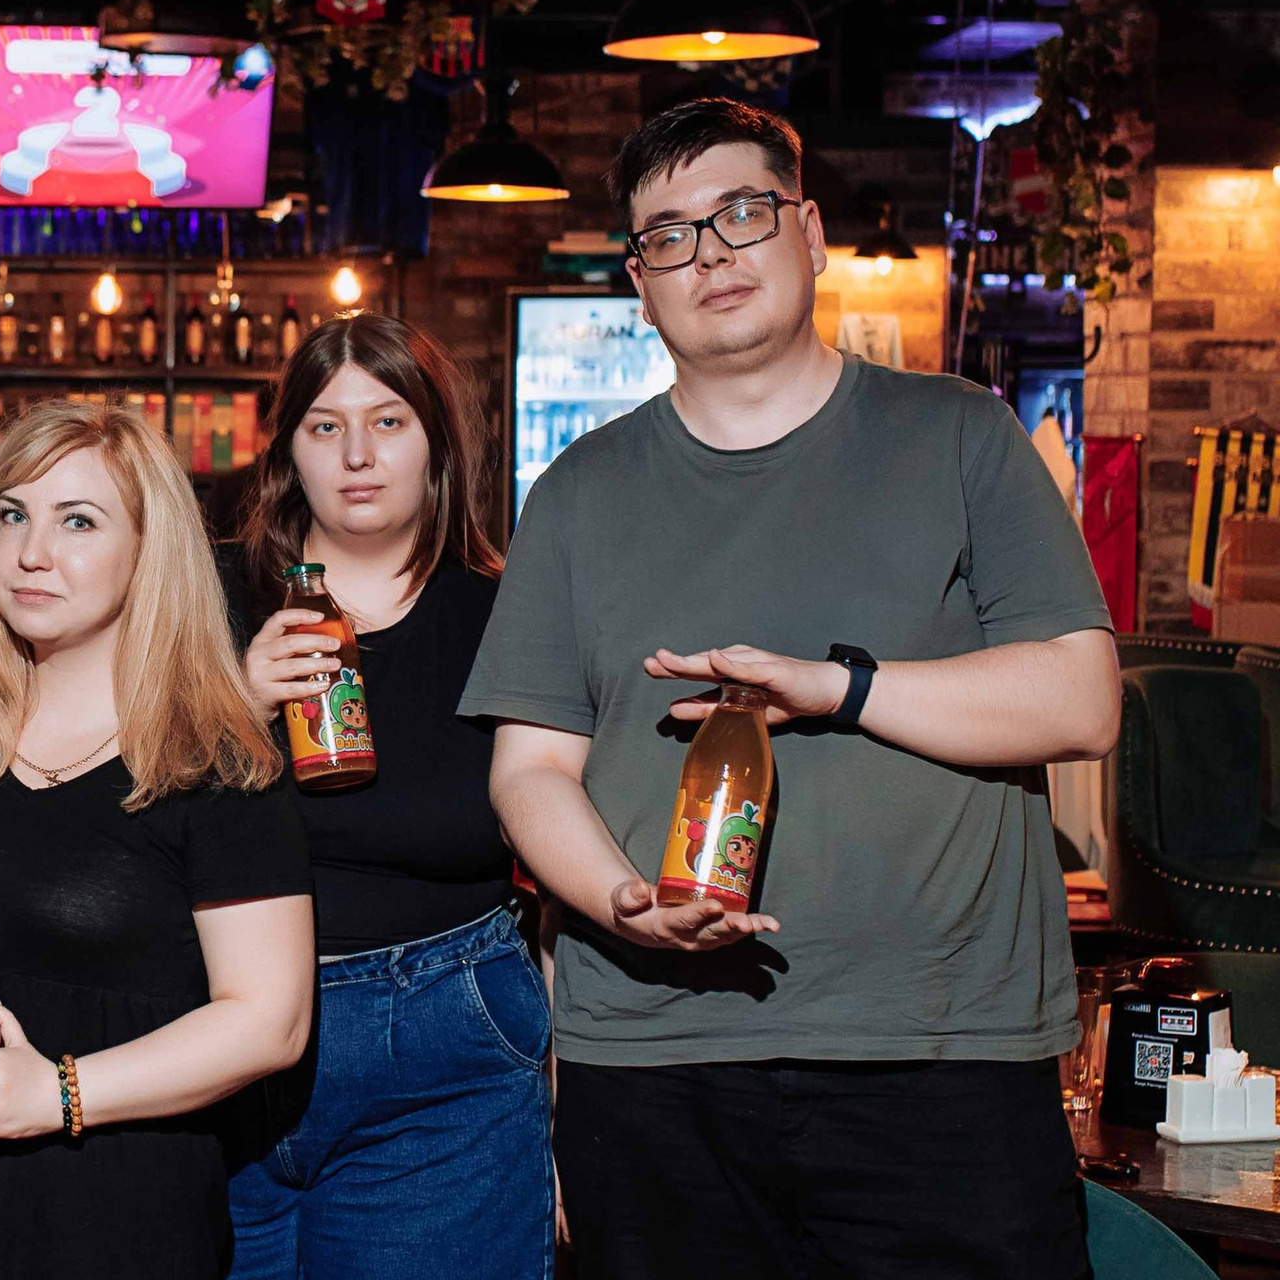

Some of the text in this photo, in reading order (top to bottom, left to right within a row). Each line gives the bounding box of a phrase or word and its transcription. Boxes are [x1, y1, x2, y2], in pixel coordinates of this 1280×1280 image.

[72, 86, 122, 137] 2
[335, 736, 359, 750] Dala
[709, 869, 734, 888] Dala
